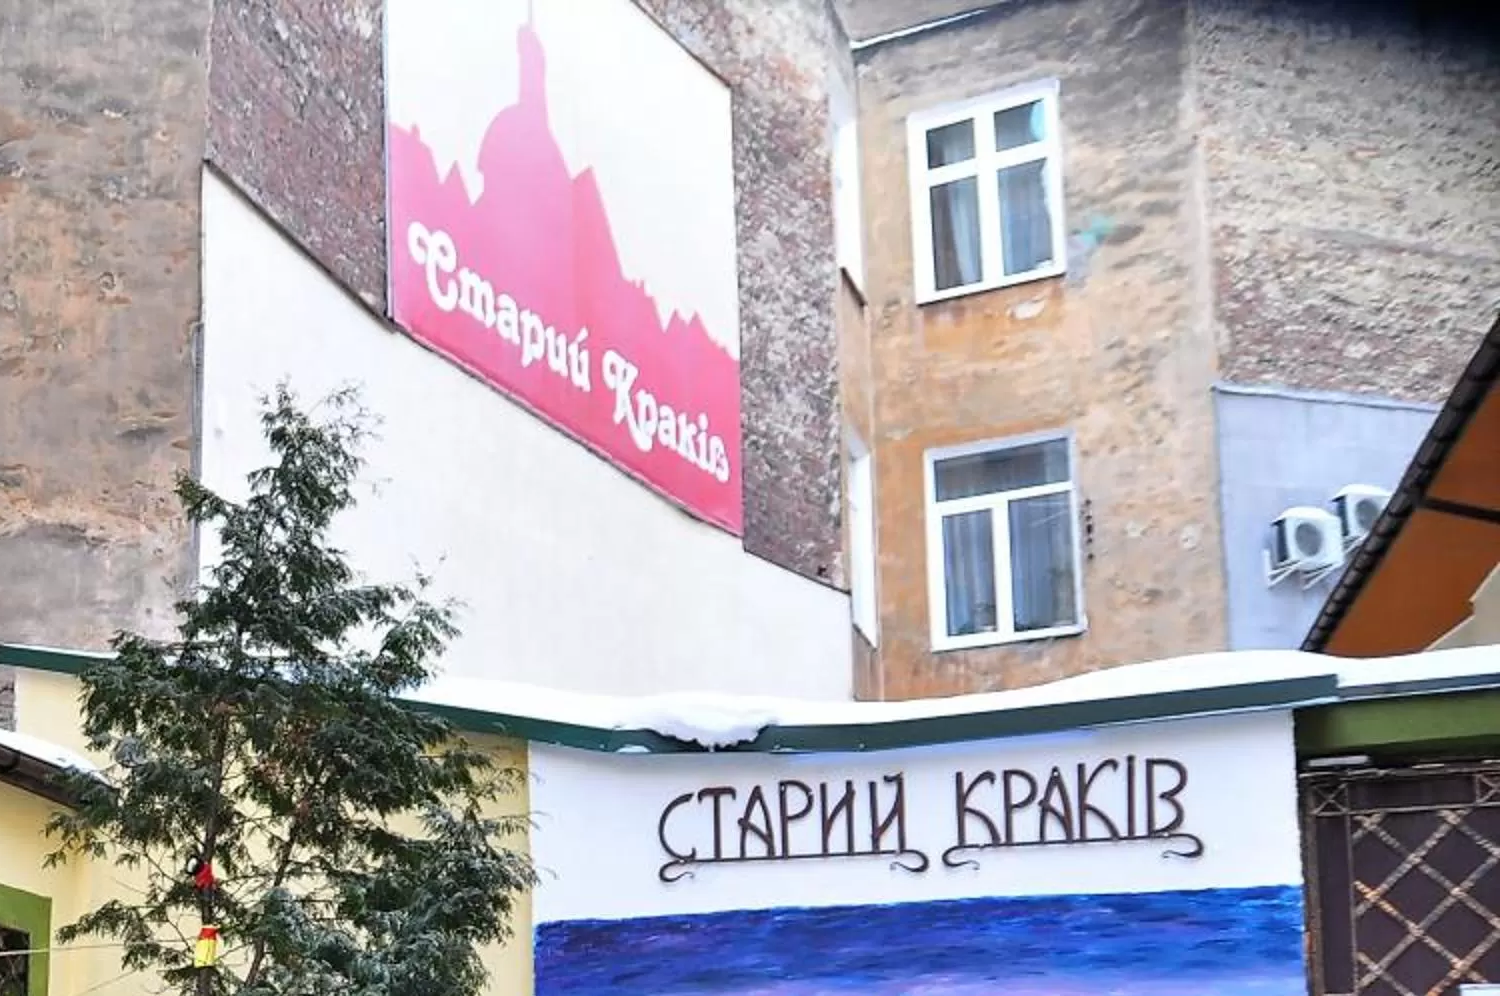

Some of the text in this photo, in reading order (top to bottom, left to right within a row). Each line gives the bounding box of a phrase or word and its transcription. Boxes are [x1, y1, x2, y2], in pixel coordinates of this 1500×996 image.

[408, 221, 730, 482] Старий Краків
[659, 755, 1188, 861] СТАРИЙ КРАКІВ
